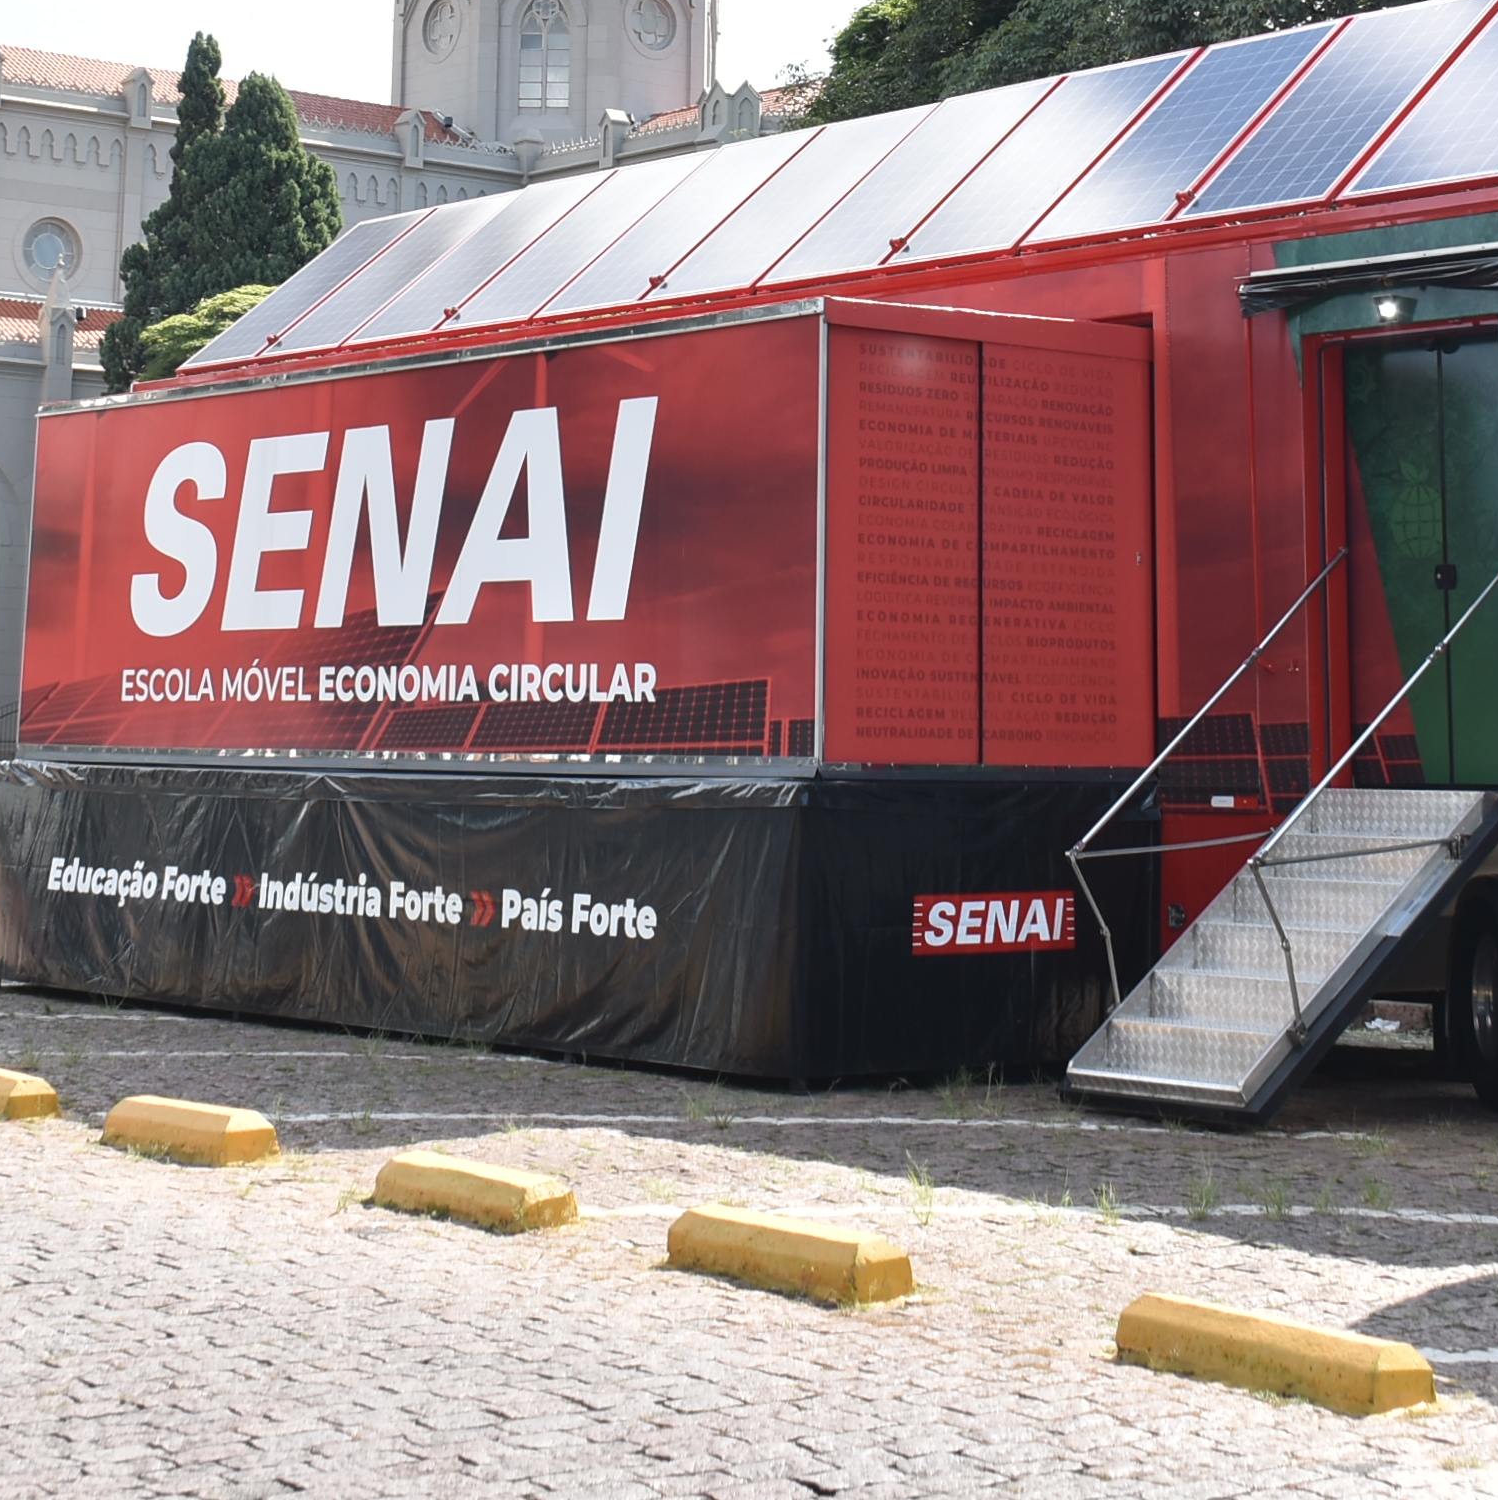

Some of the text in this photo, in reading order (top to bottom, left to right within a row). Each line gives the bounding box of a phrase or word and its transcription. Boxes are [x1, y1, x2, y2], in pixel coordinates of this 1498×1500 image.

[860, 363, 944, 382] RECICLAGEM
[1054, 382, 1113, 400] REDUÇÃO
[1013, 360, 1053, 374] CICLO
[1060, 365, 1076, 377] DE
[1083, 368, 1113, 381] VIDA
[860, 381, 1113, 418] RESÍDUOS ZERO REPARAÇÃO RENOVAÇÃO
[859, 420, 932, 436] ECONOMIA
[939, 427, 956, 438] DE
[860, 401, 961, 421] REMANUFATURA
[1039, 417, 1114, 434] RENOVÁVEIS
[859, 439, 1114, 471] VALORIZAÇÃO DE RESÍDUOS REDUÇÃO
[859, 457, 927, 475] PRODUÇÃO
[932, 463, 967, 476] LIMPA
[971, 466, 1032, 481] CONSUMO
[859, 476, 910, 491] DESIGN
[994, 486, 1043, 500] CADEIA
[1050, 491, 1065, 502] DE
[1072, 492, 1114, 506] VALOR
[127, 393, 658, 637] SENAI
[858, 495, 964, 513] CIRCULARIDADE
[858, 515, 928, 529] ECONOMIA
[1037, 526, 1114, 541] RECICLAGEM
[858, 534, 1115, 559] ECONOMIA DE COMPARTILHAMENTO
[857, 552, 1115, 577] RESPONSABILIDADE ESTENDIDA
[857, 571, 929, 586] EFICIÊNCIA
[934, 576, 950, 587] DE
[955, 577, 1023, 591] RECURSOS
[857, 589, 921, 605] LOGÍSTICA
[990, 598, 1044, 611] IMPACTO
[1048, 601, 1115, 614] AMBIENTAL
[857, 610, 1115, 632] ECONOMIA REGENERATIVA CICLO
[857, 630, 946, 644] FECHAMENTO
[951, 634, 967, 644] DE
[1026, 636, 1115, 650] BIOPRODUTOS
[857, 649, 934, 662] ECONOMIA
[942, 652, 959, 663] DE
[122, 659, 656, 702] ESCOLA MÓVEL ECONOMIA CIRCULAR
[856, 666, 925, 683] INOVAÇÃO
[1011, 692, 1053, 704] CICLO
[1060, 694, 1077, 704] DE
[1084, 694, 1116, 705] VIDA
[856, 708, 945, 720] RECICLAGEM
[1055, 710, 1116, 727] REDUÇÃO
[856, 727, 953, 739] NEUTRALIDADE
[958, 729, 973, 740] DE
[984, 730, 1042, 741] CARBONO
[48, 857, 657, 939] Educação Forte Indústria Forte País Forte
[924, 898, 1065, 949] SENAI
